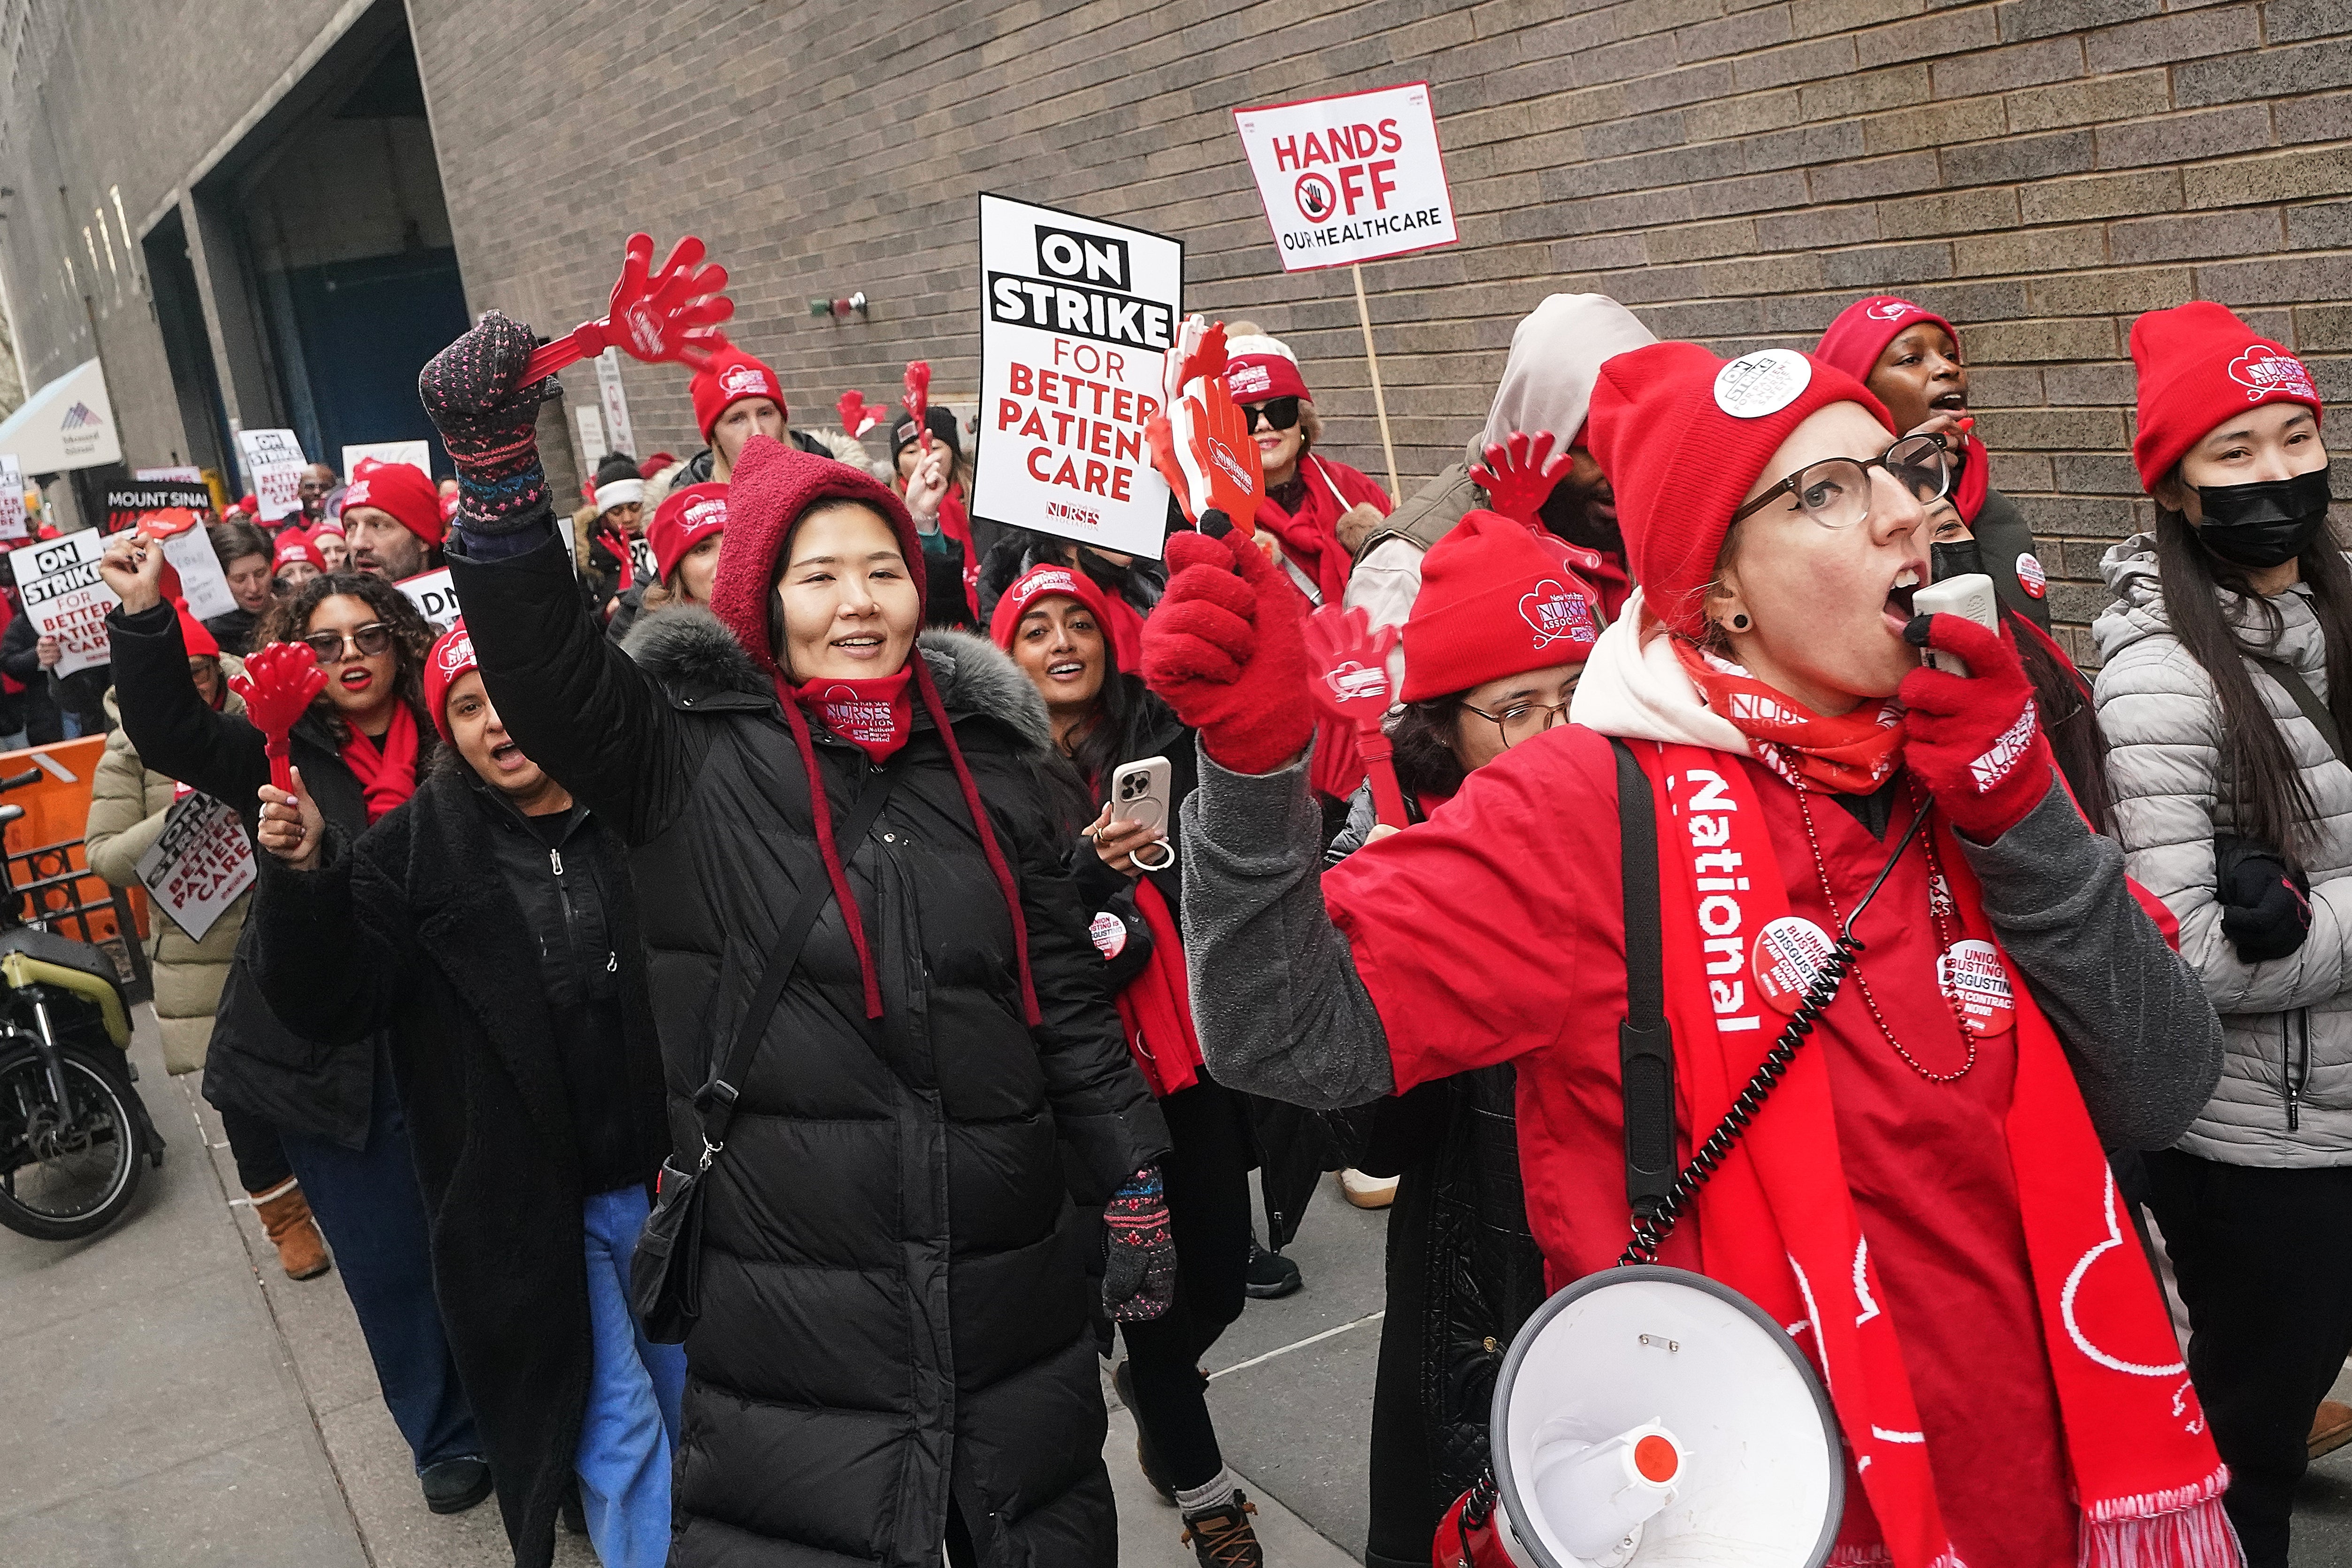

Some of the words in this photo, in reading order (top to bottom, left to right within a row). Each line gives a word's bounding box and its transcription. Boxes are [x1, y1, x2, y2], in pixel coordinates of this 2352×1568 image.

[1272, 118, 1402, 172] HANDS
[1295, 159, 1396, 223] OFF
[1284, 231, 1315, 250] OUR
[1314, 208, 1441, 247] HEALTHCARE
[1041, 234, 1122, 285] ON
[996, 277, 1170, 347] STRIKE
[1054, 338, 1124, 382] FOR
[1723, 361, 1752, 383] ON
[1726, 359, 1776, 400] STRIKE
[1734, 392, 1754, 410] FOR
[1753, 360, 1791, 391] PATIENT
[1758, 371, 1789, 397] NURSE
[1759, 377, 1792, 406] SAFETY
[999, 398, 1156, 468] PATIEN
[261, 483, 299, 494] PATIE
[262, 472, 301, 483] BETTE
[1027, 446, 1132, 502] CARE
[108, 492, 168, 507] MOUNT
[1046, 501, 1100, 525] NURSES
[38, 544, 77, 573] ON
[56, 591, 92, 610] FOR
[68, 634, 111, 653] CAR
[826, 704, 891, 721] NURSES
[163, 800, 200, 845] ON
[150, 803, 216, 886] STRIK
[169, 823, 226, 893] BETTE
[172, 827, 242, 909] PATIEN
[198, 842, 253, 900] CARE
[1686, 769, 1760, 1032] National
[1762, 938, 1783, 961] FAIR
[1778, 960, 1809, 997] CONTRA
[1770, 966, 1794, 993] NOW!
[1964, 1003, 1993, 1016] NOW!
